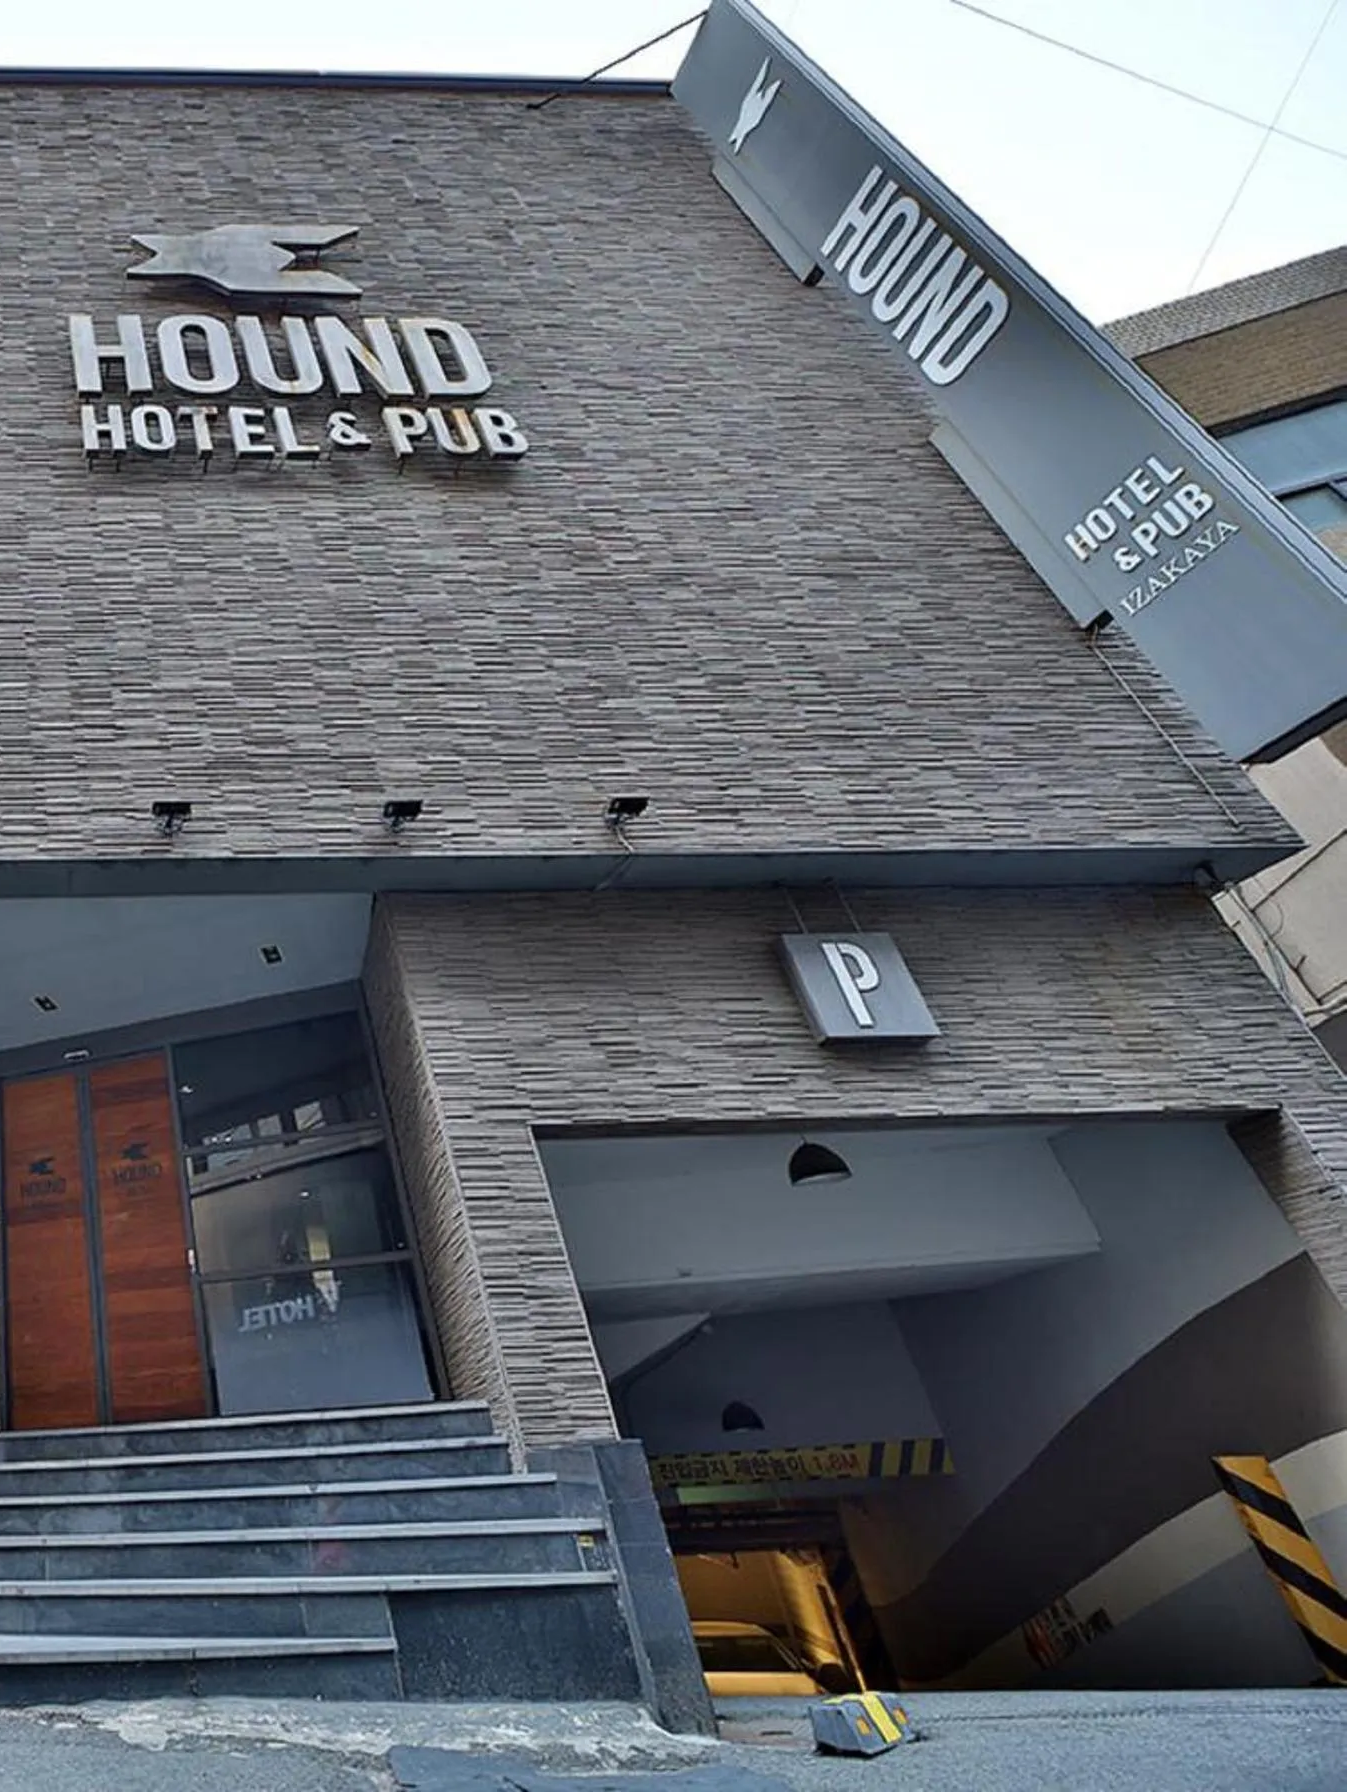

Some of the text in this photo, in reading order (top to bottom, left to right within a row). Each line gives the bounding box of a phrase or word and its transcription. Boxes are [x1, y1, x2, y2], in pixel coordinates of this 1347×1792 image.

[820, 165, 1009, 386] HOUND
[69, 314, 493, 398] HOUND
[81, 404, 530, 459] HOTEL & PUB
[1064, 454, 1185, 562] HOTEL
[1120, 520, 1241, 616] IZAKAYA
[821, 942, 879, 1026] P
